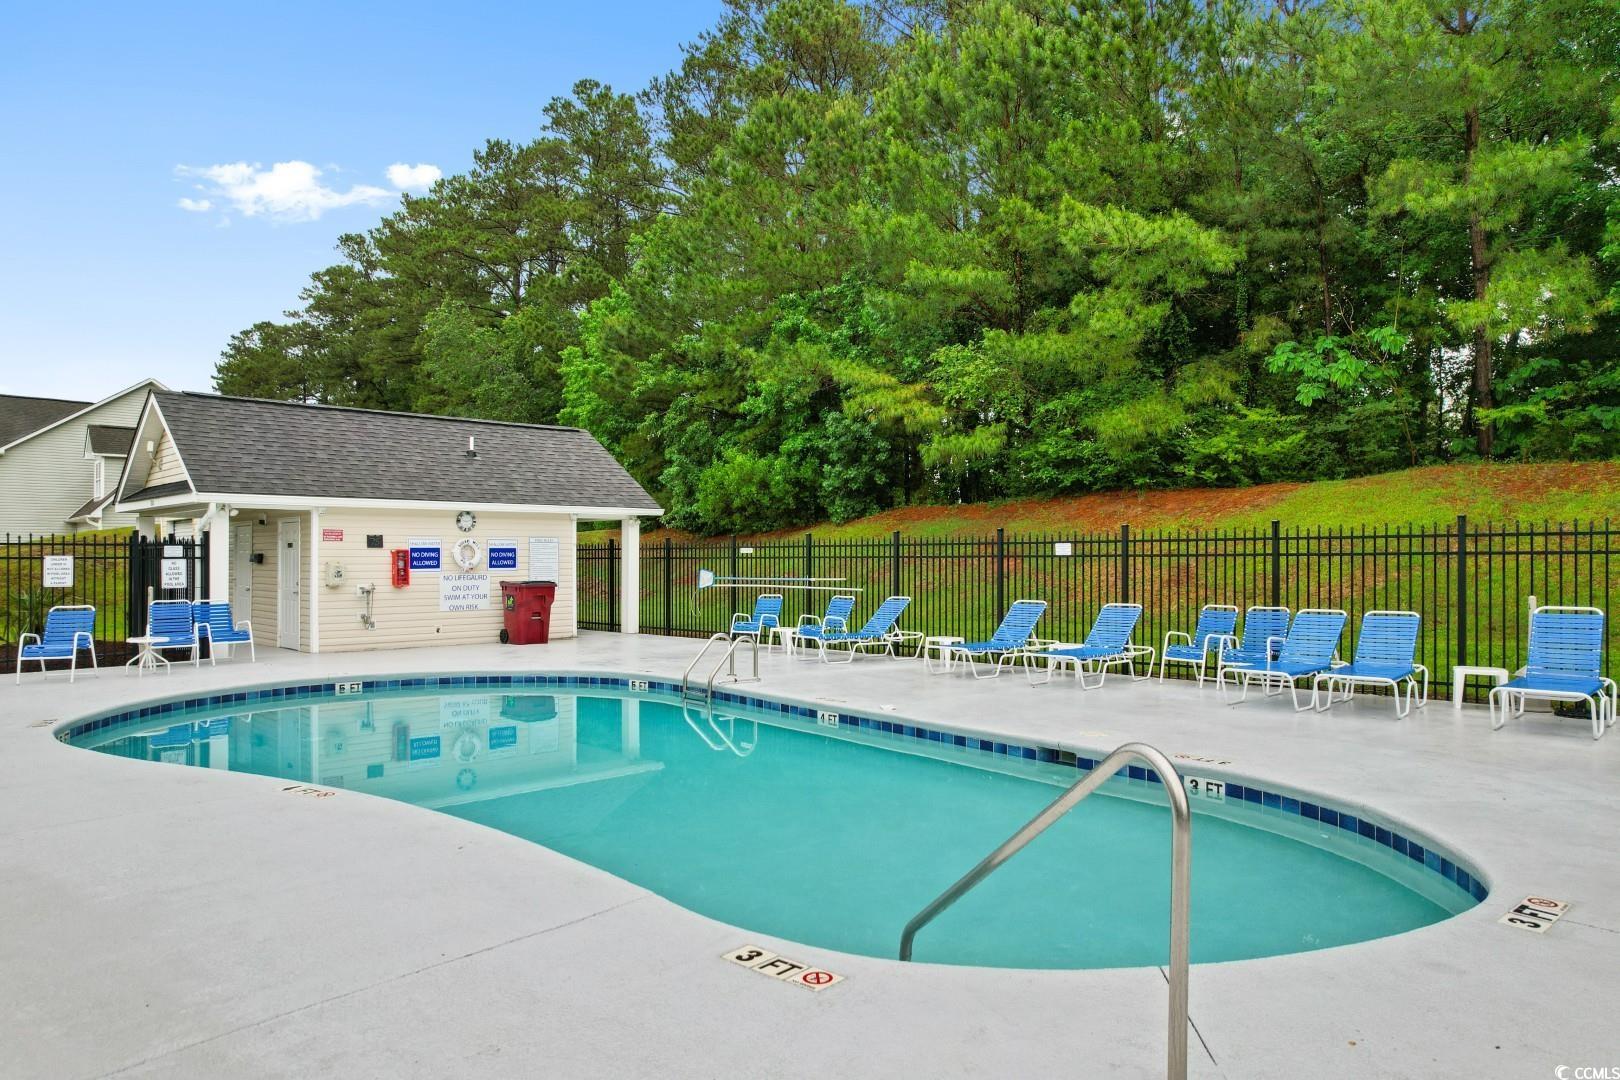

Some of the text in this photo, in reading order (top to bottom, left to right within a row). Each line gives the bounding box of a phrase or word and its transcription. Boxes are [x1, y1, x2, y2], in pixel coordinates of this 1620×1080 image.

[1190, 779, 1222, 796] 3 FT
[1513, 904, 1559, 922] FT
[1508, 918, 1541, 928] 3
[735, 950, 803, 976] 3 FT
